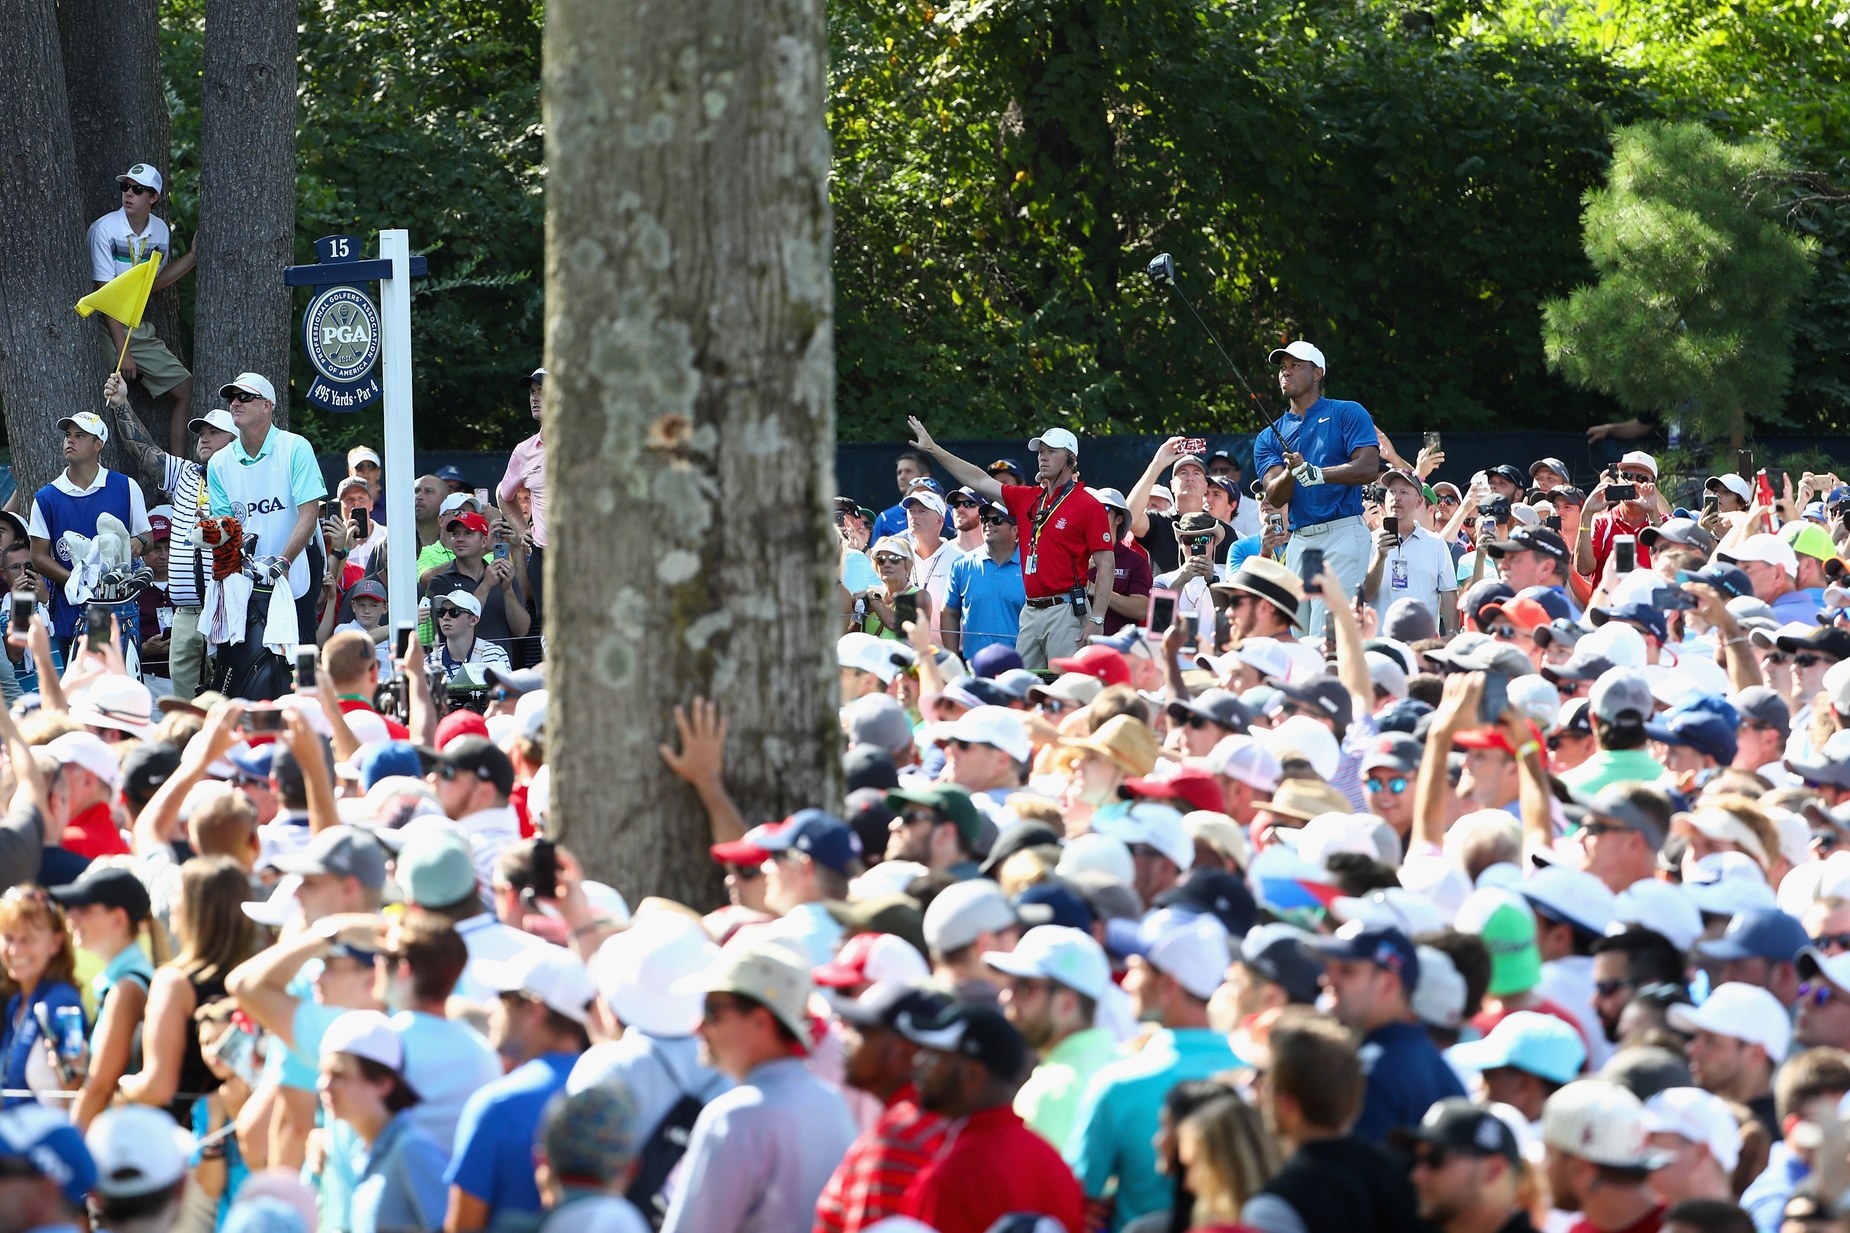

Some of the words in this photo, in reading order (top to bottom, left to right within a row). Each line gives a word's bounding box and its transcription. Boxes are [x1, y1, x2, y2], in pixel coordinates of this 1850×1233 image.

[330, 238, 350, 258] 15
[313, 302, 329, 364] PROFESSIONAL
[322, 325, 369, 345] PGA
[361, 302, 378, 359] ASSOCIATION
[328, 365, 338, 374] OF
[338, 361, 368, 376] AMERICA
[315, 384, 331, 402] 495
[331, 390, 354, 406] Yards
[355, 388, 372, 403] Par
[370, 379, 379, 392] 4
[247, 496, 286, 518] PGA
